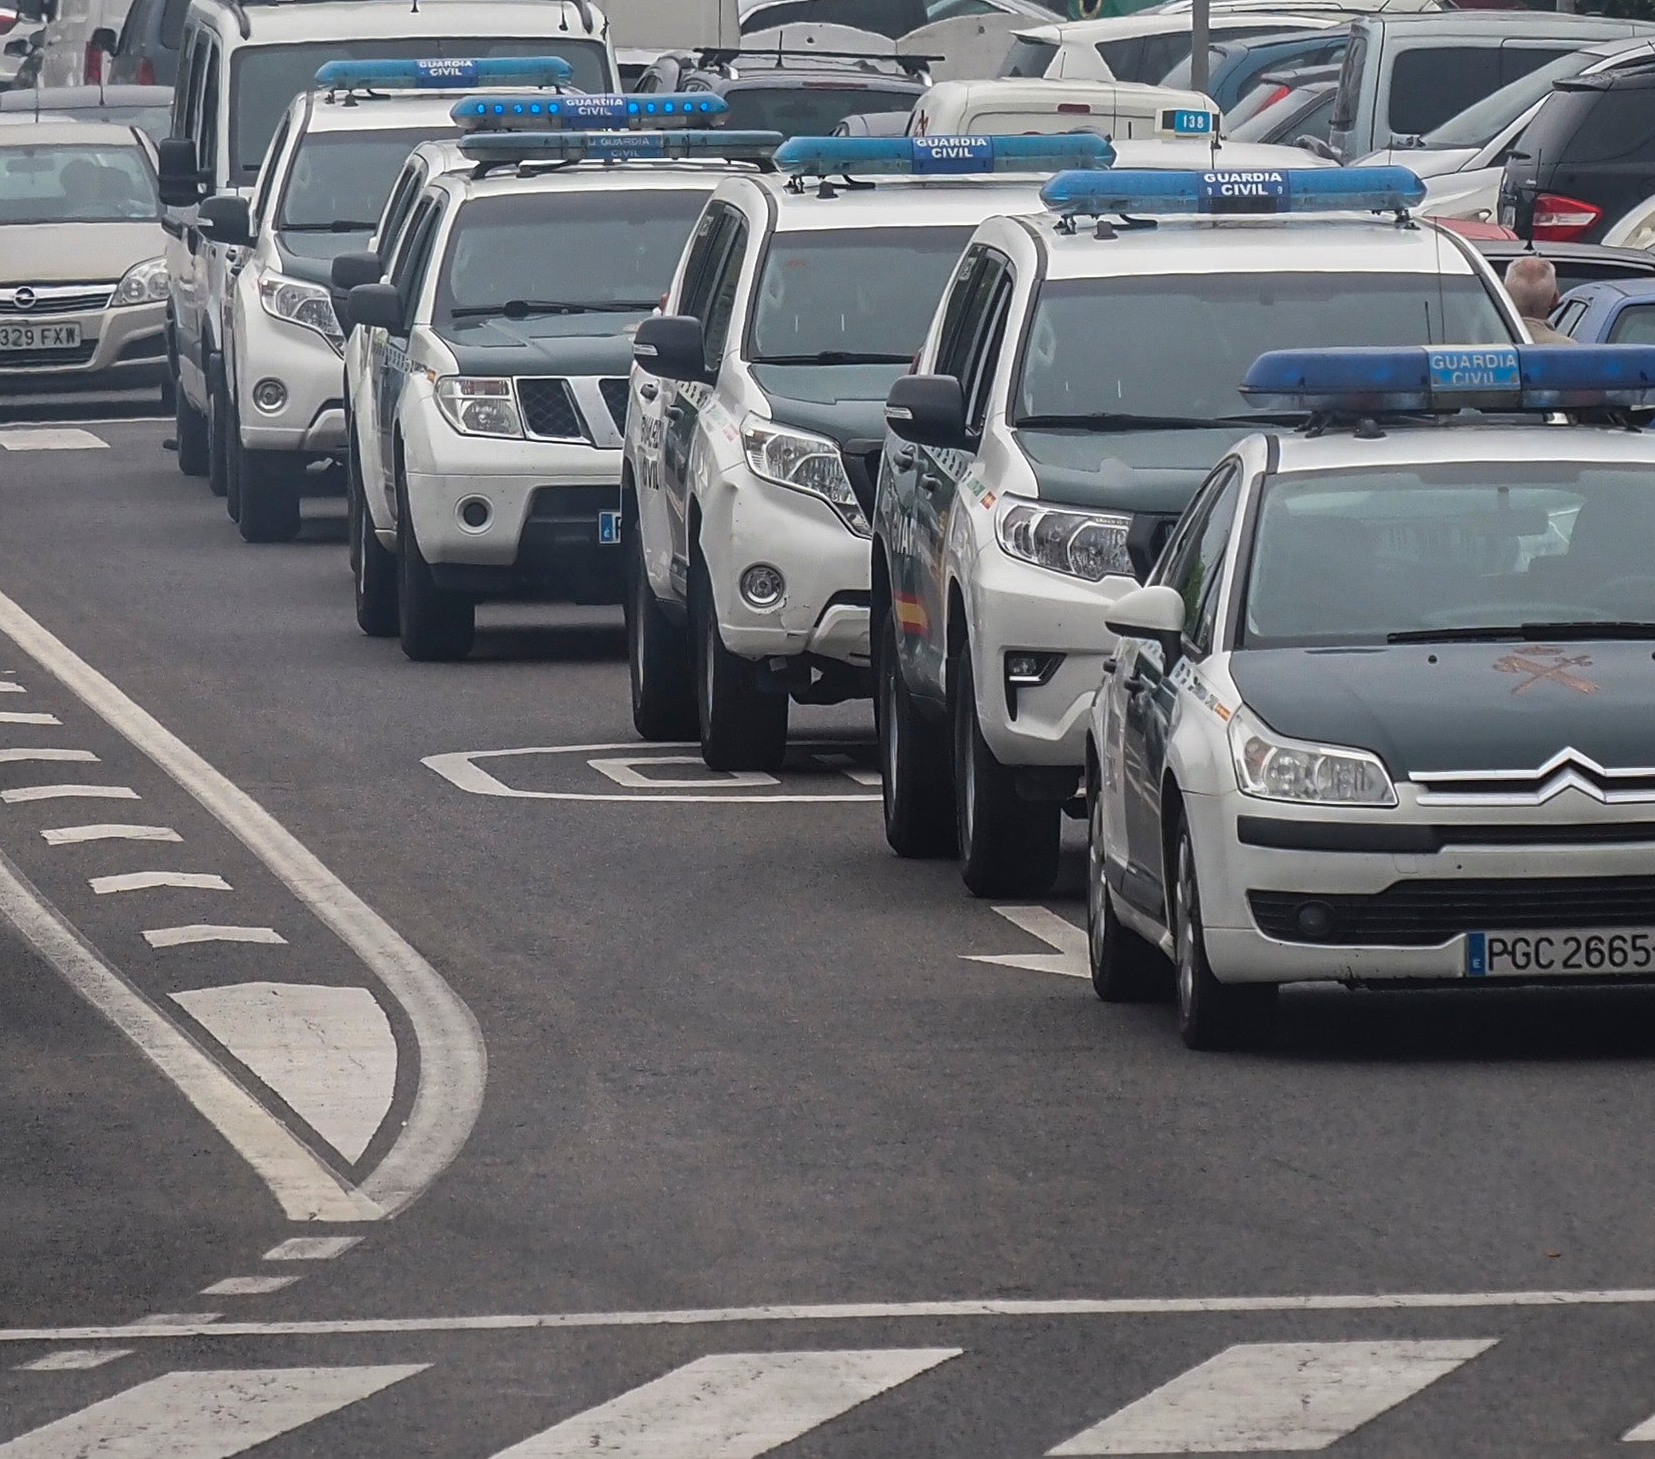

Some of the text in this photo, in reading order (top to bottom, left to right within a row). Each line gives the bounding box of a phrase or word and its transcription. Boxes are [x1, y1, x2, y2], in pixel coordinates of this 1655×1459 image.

[419, 60, 474, 69] GUARDIA
[429, 67, 463, 77] CIVIL
[565, 97, 624, 107] GUARDIA
[577, 106, 613, 117] CIVIL
[1182, 114, 1205, 129] 138
[600, 137, 650, 147] GUARDIA
[916, 136, 988, 147] GUARDIA
[931, 146, 974, 159] CIVIL
[1203, 171, 1283, 184] GUARDIA
[1220, 182, 1269, 197] CIVIL
[1431, 353, 1518, 370] GUARDIA
[1451, 370, 1495, 384] CIVIL
[1487, 936, 1555, 972] PGC
